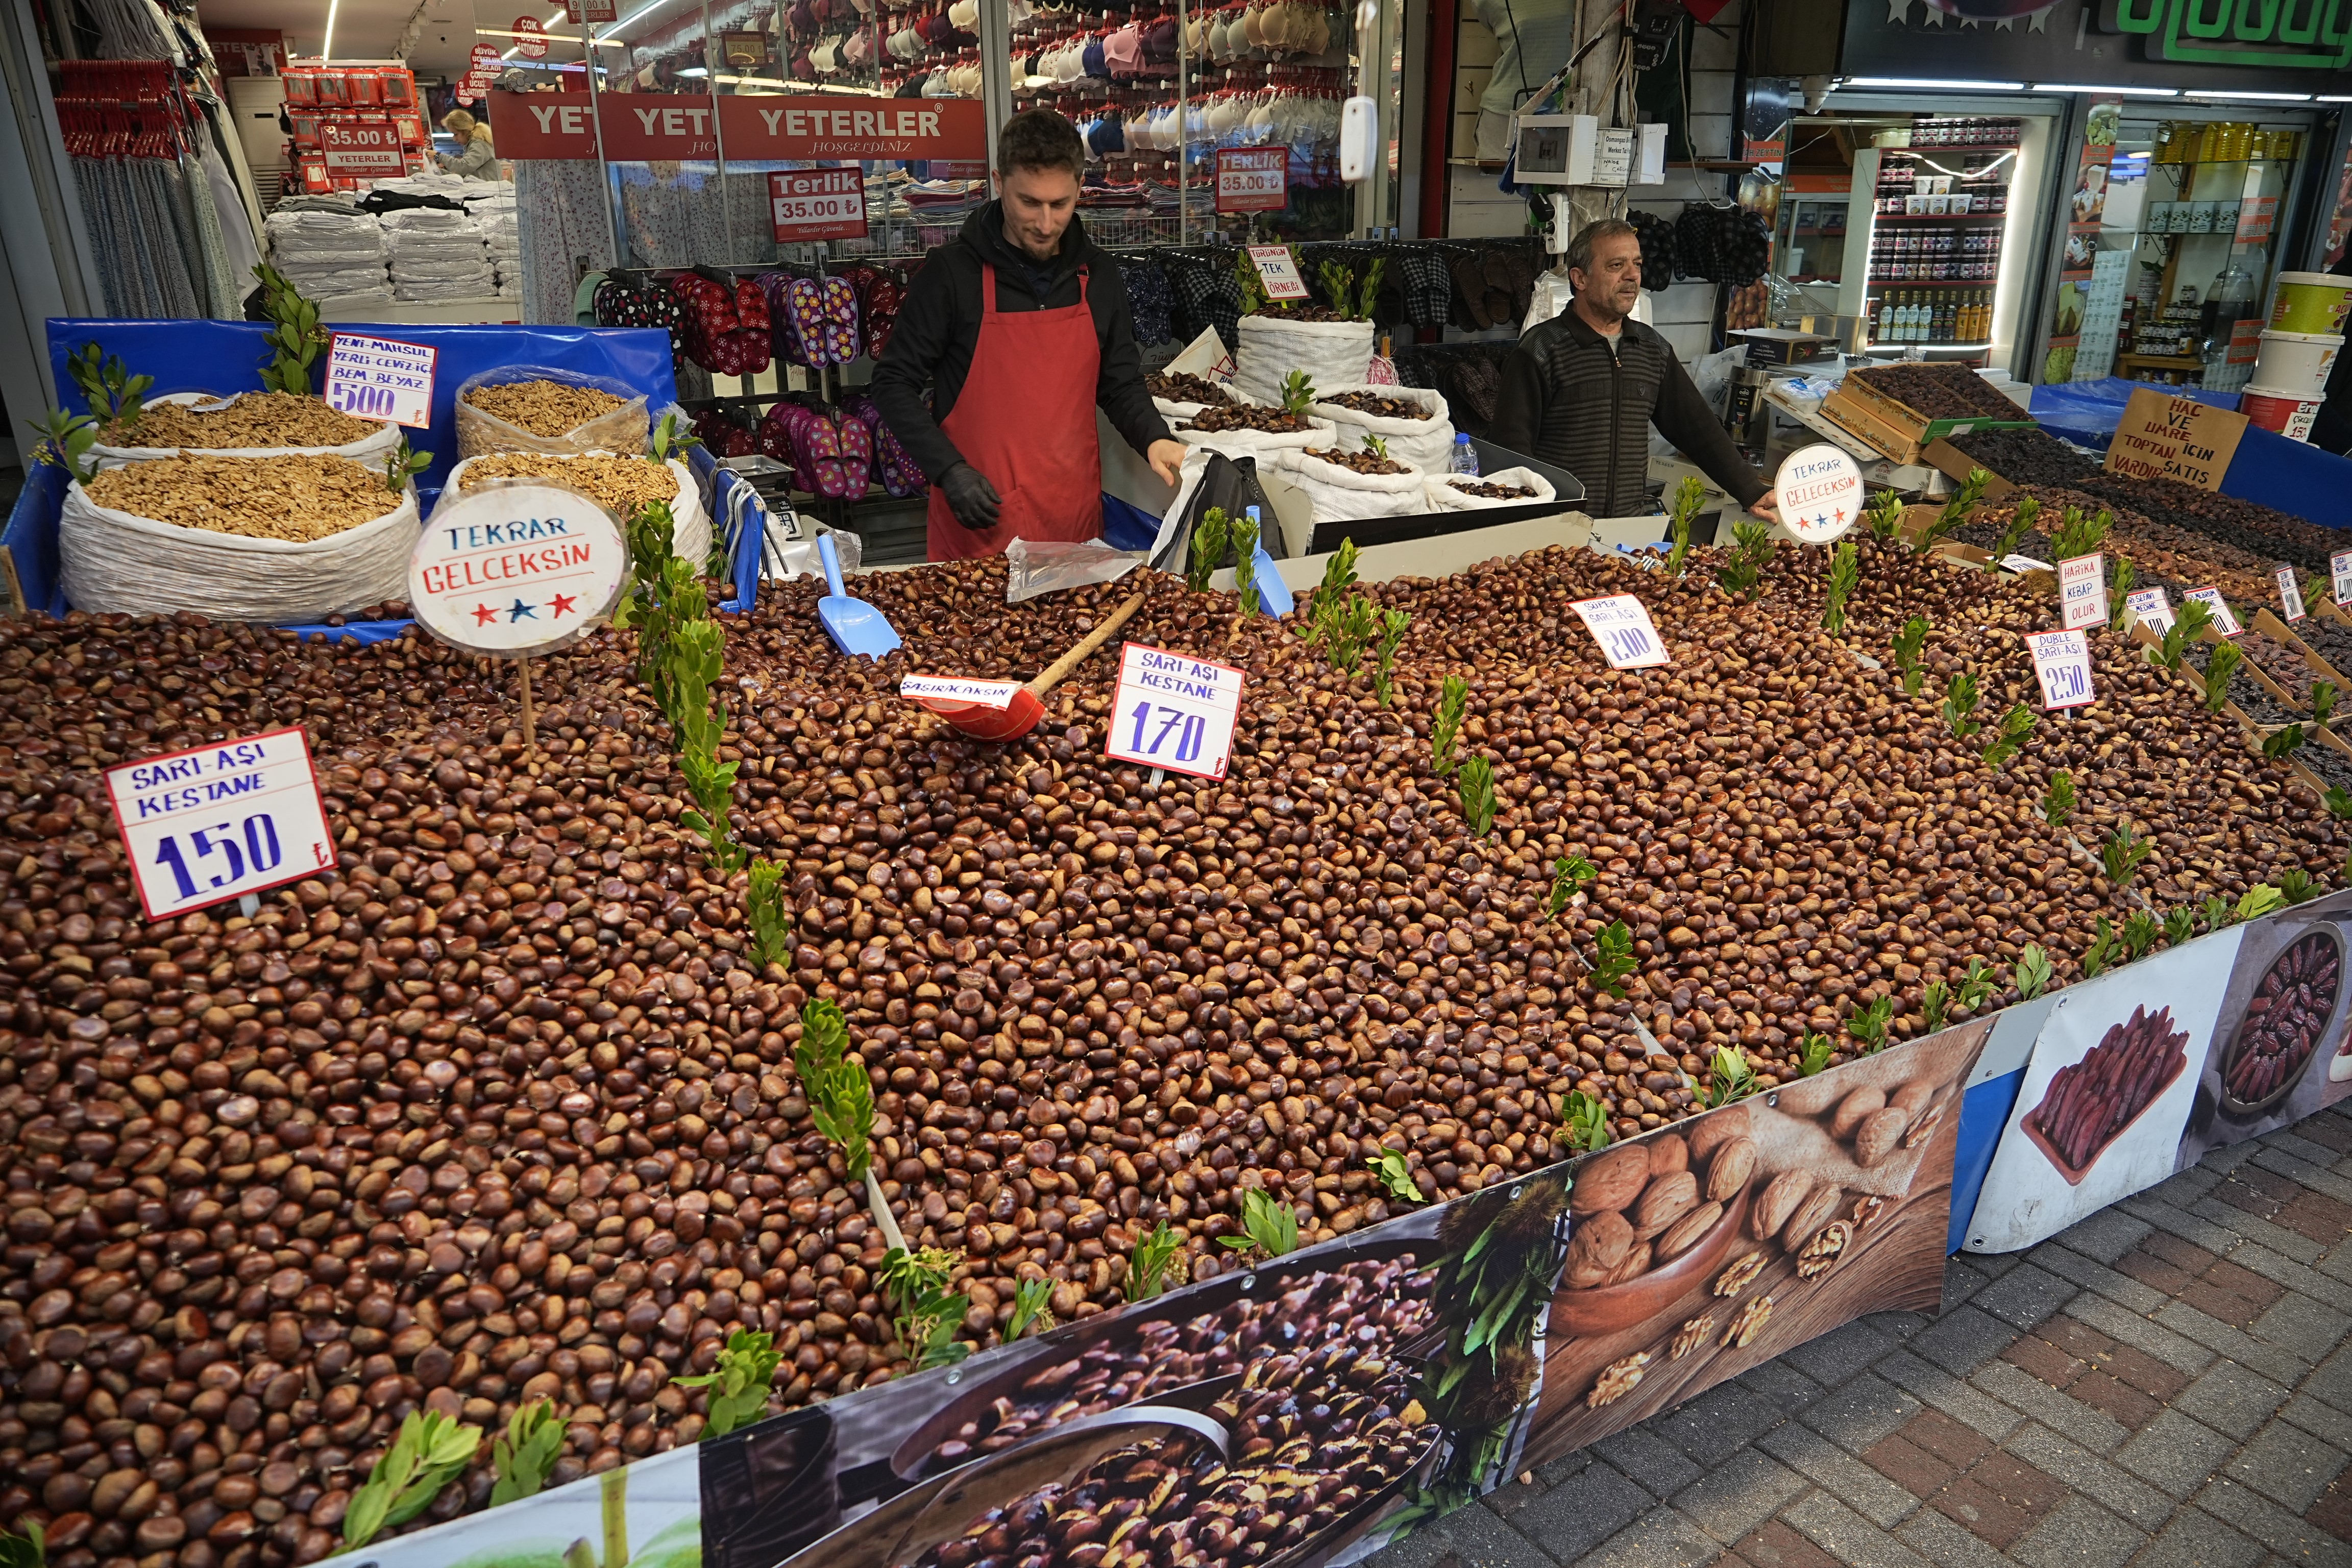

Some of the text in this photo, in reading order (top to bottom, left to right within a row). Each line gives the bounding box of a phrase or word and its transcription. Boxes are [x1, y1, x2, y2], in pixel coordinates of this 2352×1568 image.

[521, 19, 537, 31] ÇOK
[517, 42, 546, 57] SATIYORUZ
[758, 109, 941, 136] YETERLER
[330, 131, 397, 145] 35.00 ₺
[808, 140, 912, 155] HOŞGELDİNİZ
[1756, 148, 1781, 157] ZEYTİN
[1219, 152, 1281, 169] TERLİK
[774, 173, 859, 194] Terlik
[1222, 176, 1264, 190] 35.00
[781, 200, 857, 218] 35.00 ₺
[1251, 249, 1286, 258] TÜRÜNÜN
[1262, 263, 1284, 274] TEK
[1268, 281, 1299, 293] ÖRNEĞİ
[334, 383, 423, 423] 500 ₺
[2169, 399, 2203, 416] HAC
[2169, 412, 2193, 429] VE
[2145, 422, 2215, 461] UMRE İÇİN
[2115, 455, 2163, 478] VARDIR
[2125, 434, 2209, 484] TOPTAN SATIŞ
[1792, 459, 1841, 479] TEKRAR
[1786, 476, 1855, 507] GELECEKSİN
[443, 518, 568, 550] TEKRAR
[423, 544, 590, 594] GELCEKSİN
[2065, 561, 2095, 579] HARİKA
[2068, 583, 2092, 598] KEBAP
[1584, 600, 1618, 610] SÜPER
[2072, 603, 2096, 620] OLUR
[1589, 609, 1637, 623] SARI-AŞI
[1603, 628, 1651, 661] 200
[2039, 633, 2071, 646] DUBLE
[2038, 644, 2081, 659] SARI-AŞI
[1141, 653, 1217, 681] SARI-AŞI
[1140, 672, 1216, 700] KESTANE
[2046, 665, 2084, 701] 250
[1127, 701, 1224, 775] 170 ₺
[132, 744, 265, 790] SARI-AŞI
[138, 773, 266, 818] KESTANE
[156, 814, 329, 903] 150 ₺
